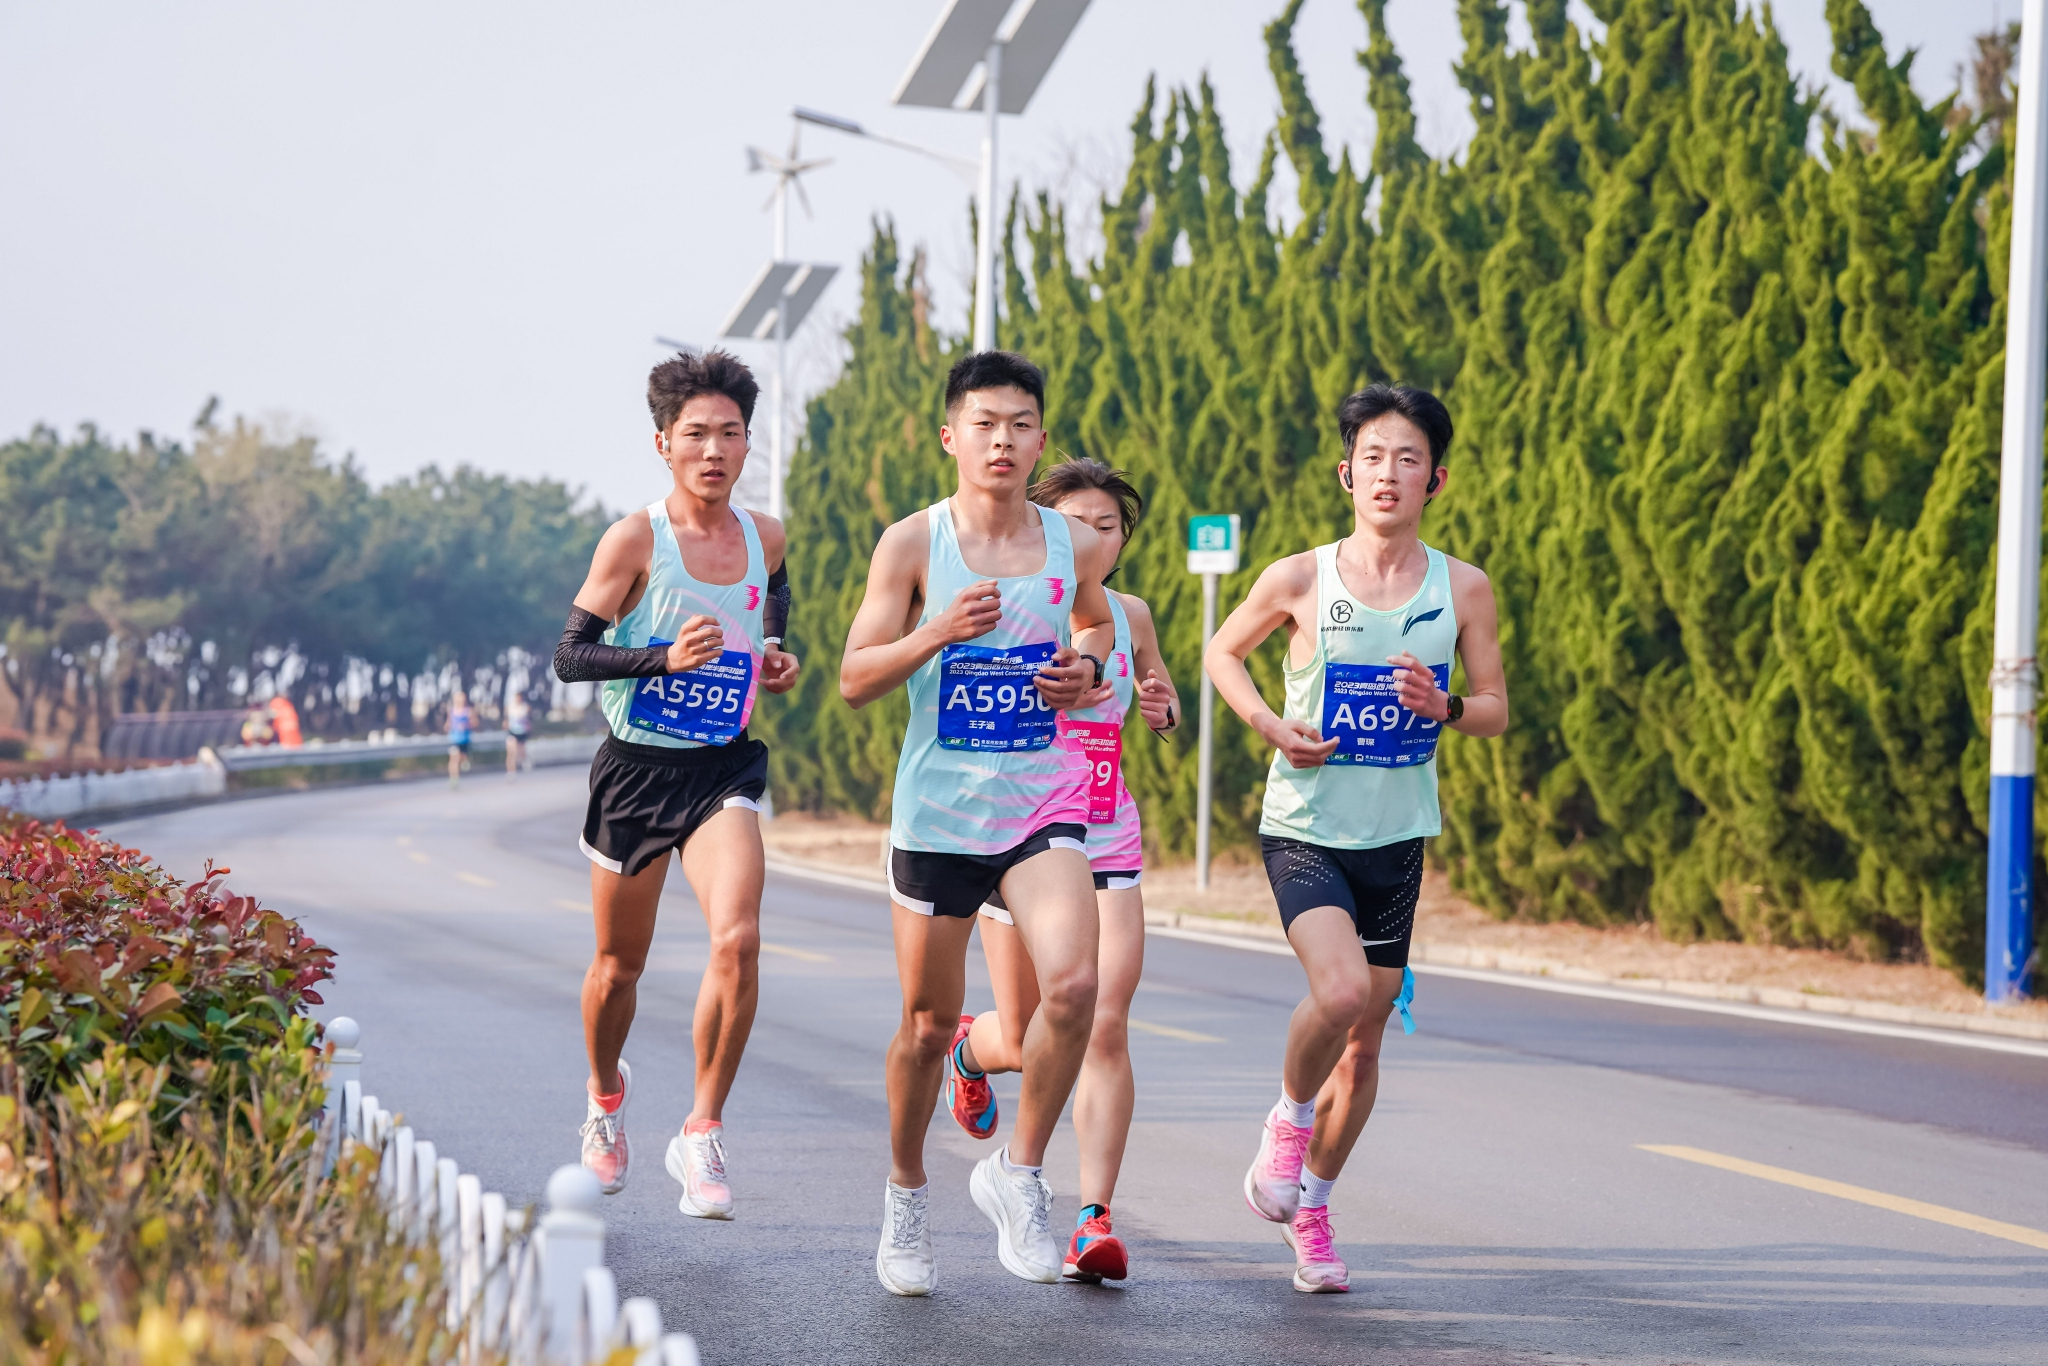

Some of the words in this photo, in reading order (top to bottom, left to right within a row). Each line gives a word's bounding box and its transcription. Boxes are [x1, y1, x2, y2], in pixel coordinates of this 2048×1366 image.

[641, 676, 740, 714] A5595
[968, 720, 995, 730] 王子涵
